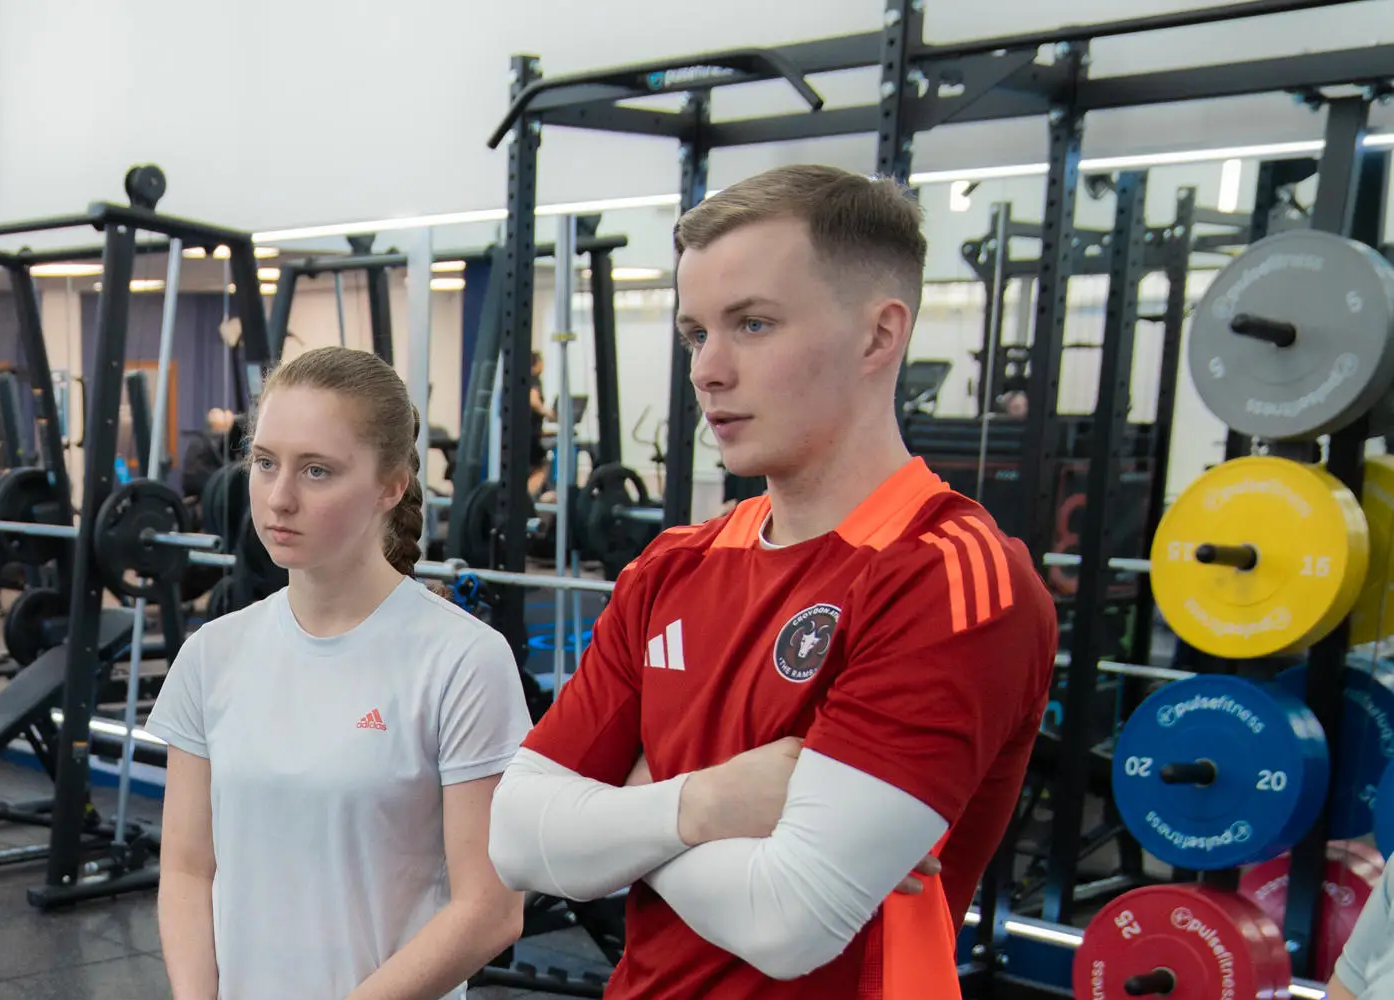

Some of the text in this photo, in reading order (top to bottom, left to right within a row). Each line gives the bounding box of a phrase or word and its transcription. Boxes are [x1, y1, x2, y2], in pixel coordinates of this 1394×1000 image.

[1167, 541, 1194, 562] 15
[1300, 555, 1331, 577] 15
[792, 607, 829, 627] CROYDON
[779, 660, 814, 678] THE RAMS
[1175, 694, 1266, 734] pulsefitness
[356, 720, 387, 731] adidas
[1124, 756, 1154, 777] 20
[1256, 769, 1288, 792] 20
[1145, 810, 1234, 852] pulsefitness
[1114, 909, 1142, 940] 25
